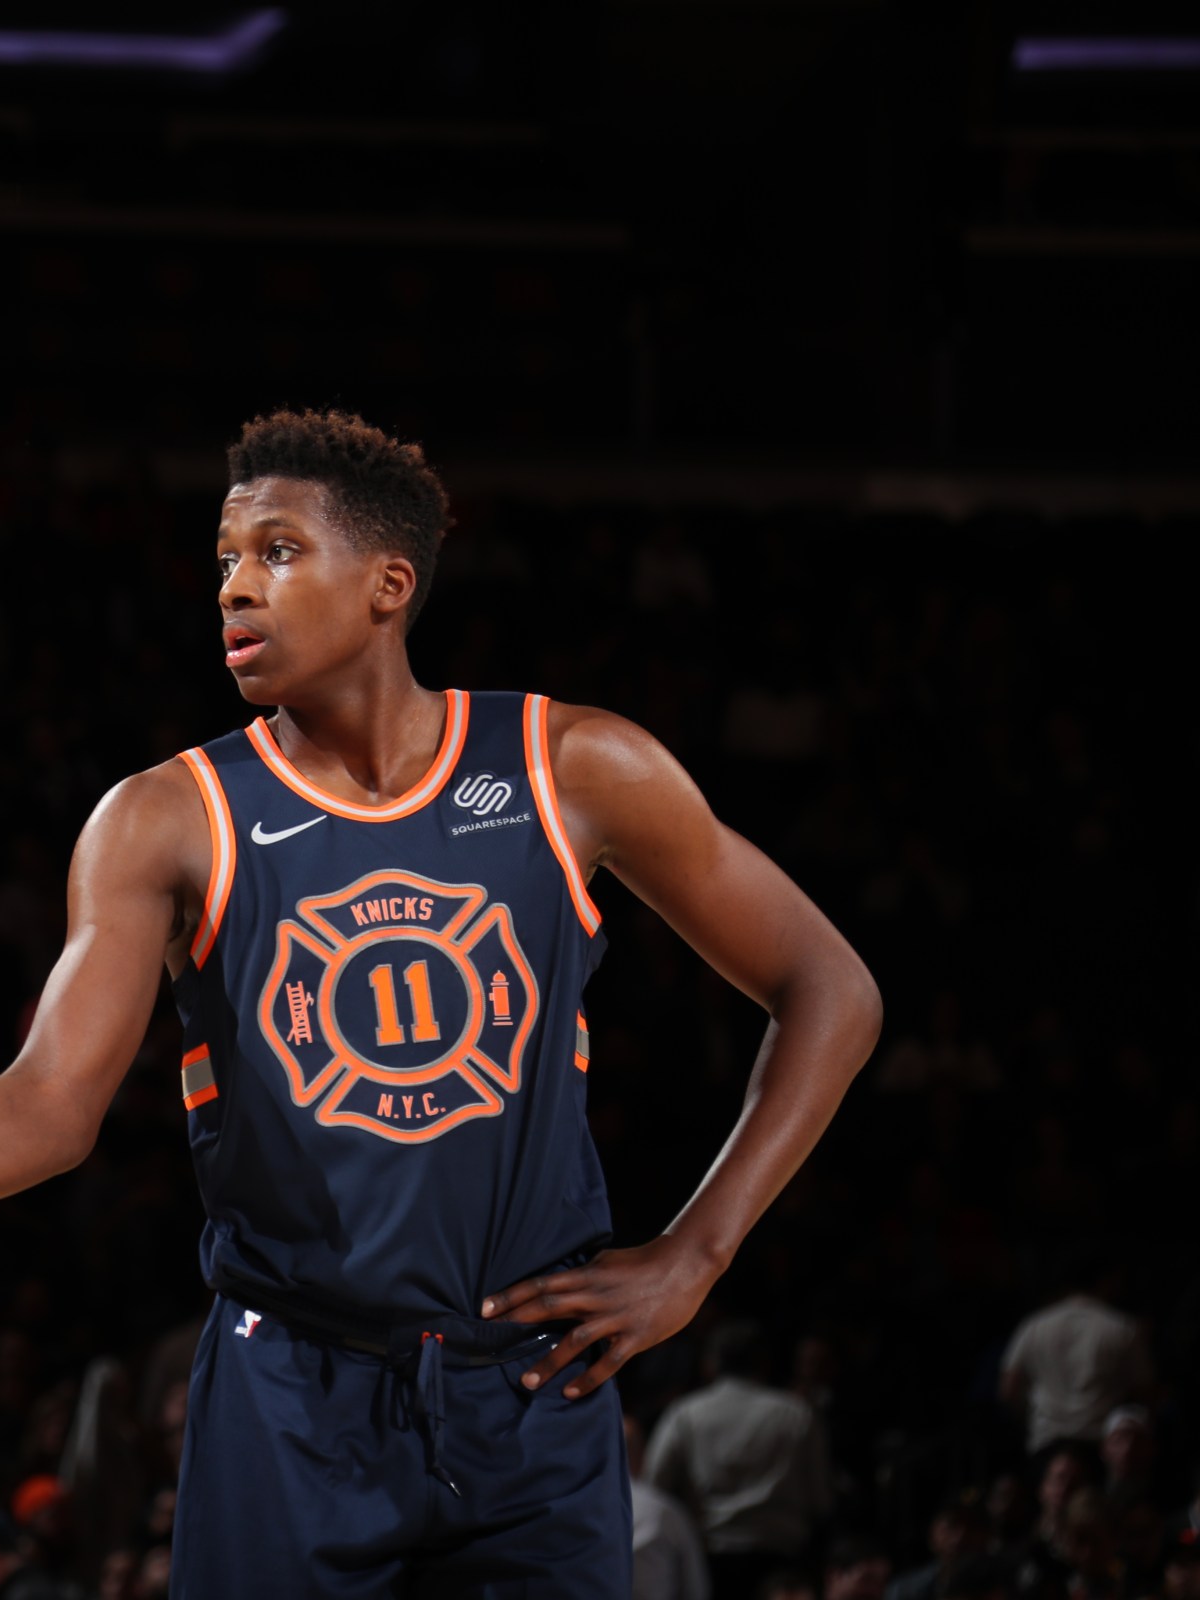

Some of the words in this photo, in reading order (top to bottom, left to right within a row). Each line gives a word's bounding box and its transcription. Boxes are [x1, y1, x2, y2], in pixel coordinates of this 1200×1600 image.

[451, 813, 531, 836] SQUARESPACE
[350, 897, 434, 926] KNICKS
[368, 959, 441, 1047] 11
[376, 1092, 447, 1119] N.Y.C.
